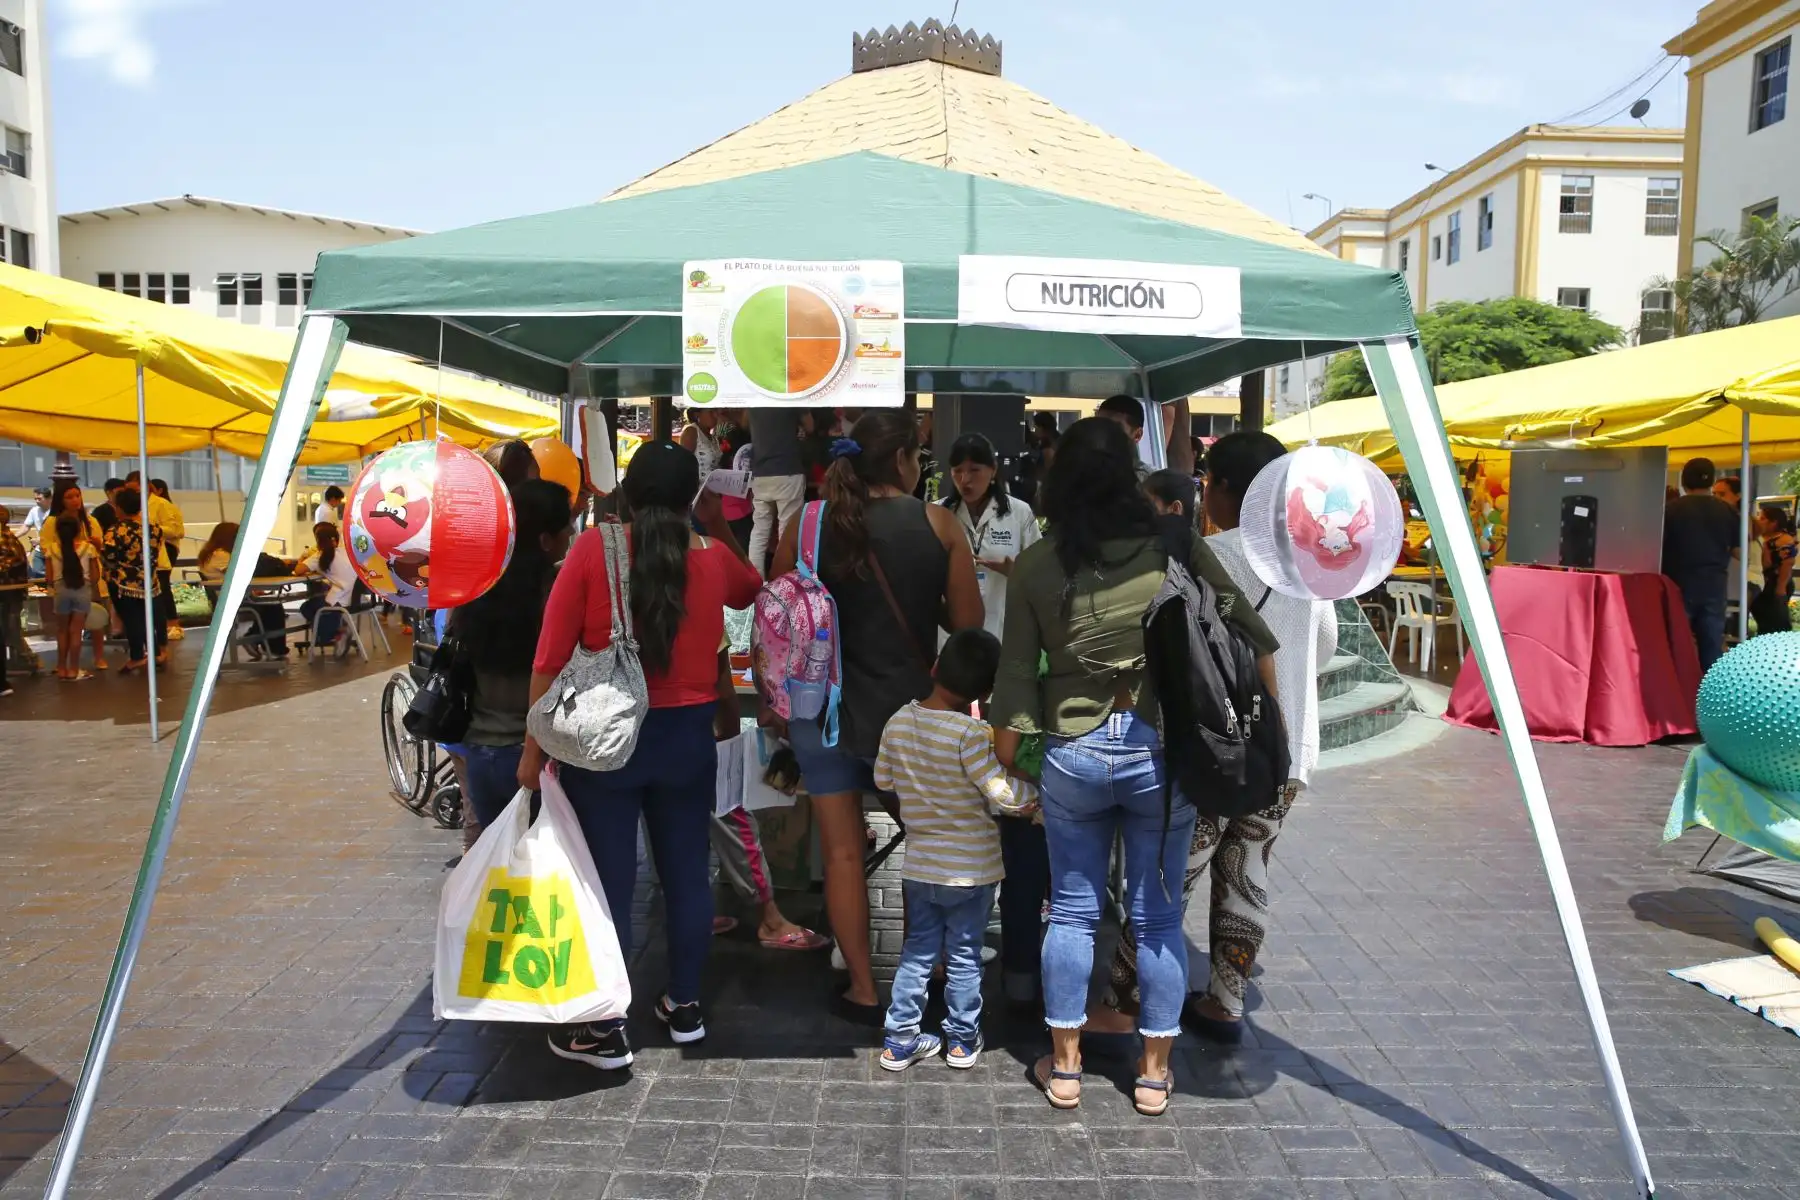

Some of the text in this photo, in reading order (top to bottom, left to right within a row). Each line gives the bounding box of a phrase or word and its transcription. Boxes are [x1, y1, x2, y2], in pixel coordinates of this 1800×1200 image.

[724, 262, 733, 271] EL
[735, 262, 760, 270] PLATO
[762, 263, 773, 271] DE
[775, 263, 785, 271] LA
[1041, 281, 1165, 309] NUTRICIÓN
